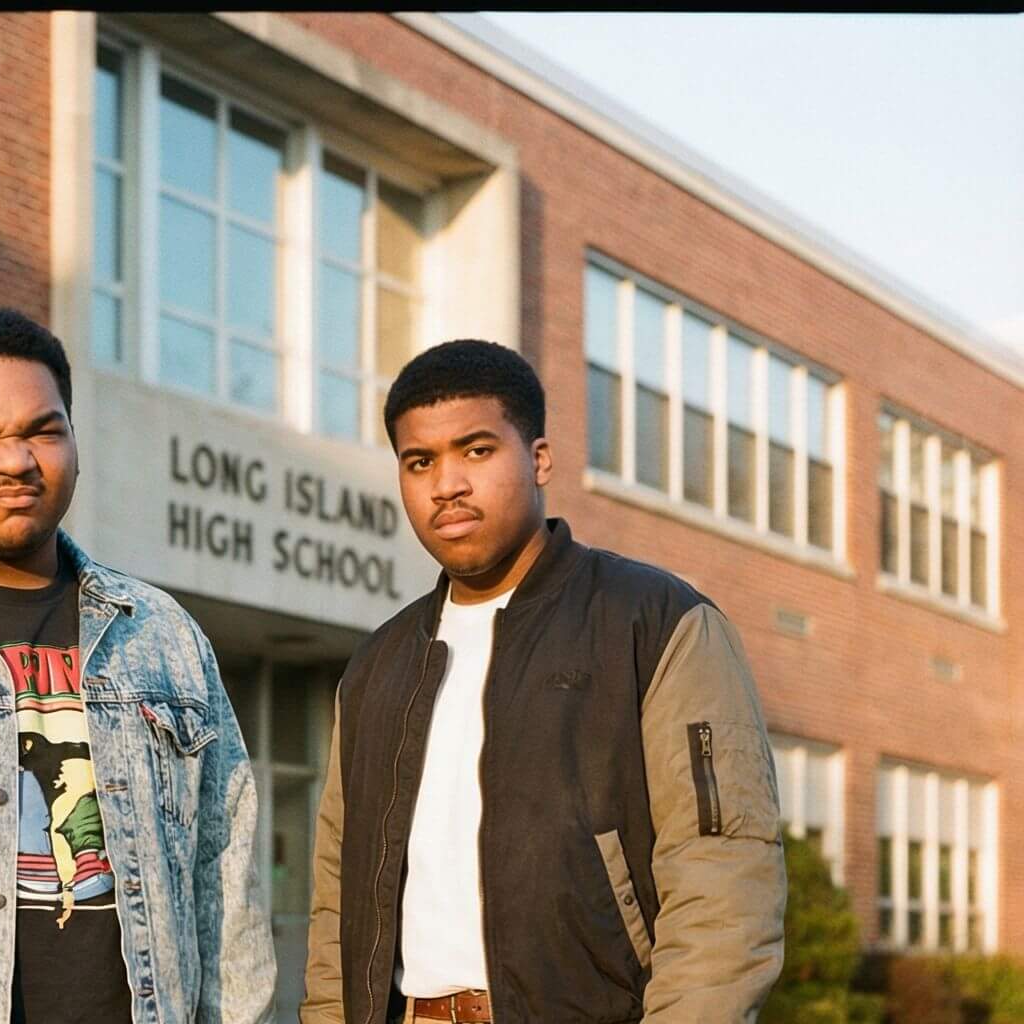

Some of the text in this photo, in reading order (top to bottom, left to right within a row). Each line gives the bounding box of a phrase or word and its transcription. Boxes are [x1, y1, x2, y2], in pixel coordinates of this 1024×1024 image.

[170, 437, 397, 538] LONG ISLAND
[169, 504, 401, 599] HIGH SCHOOL
